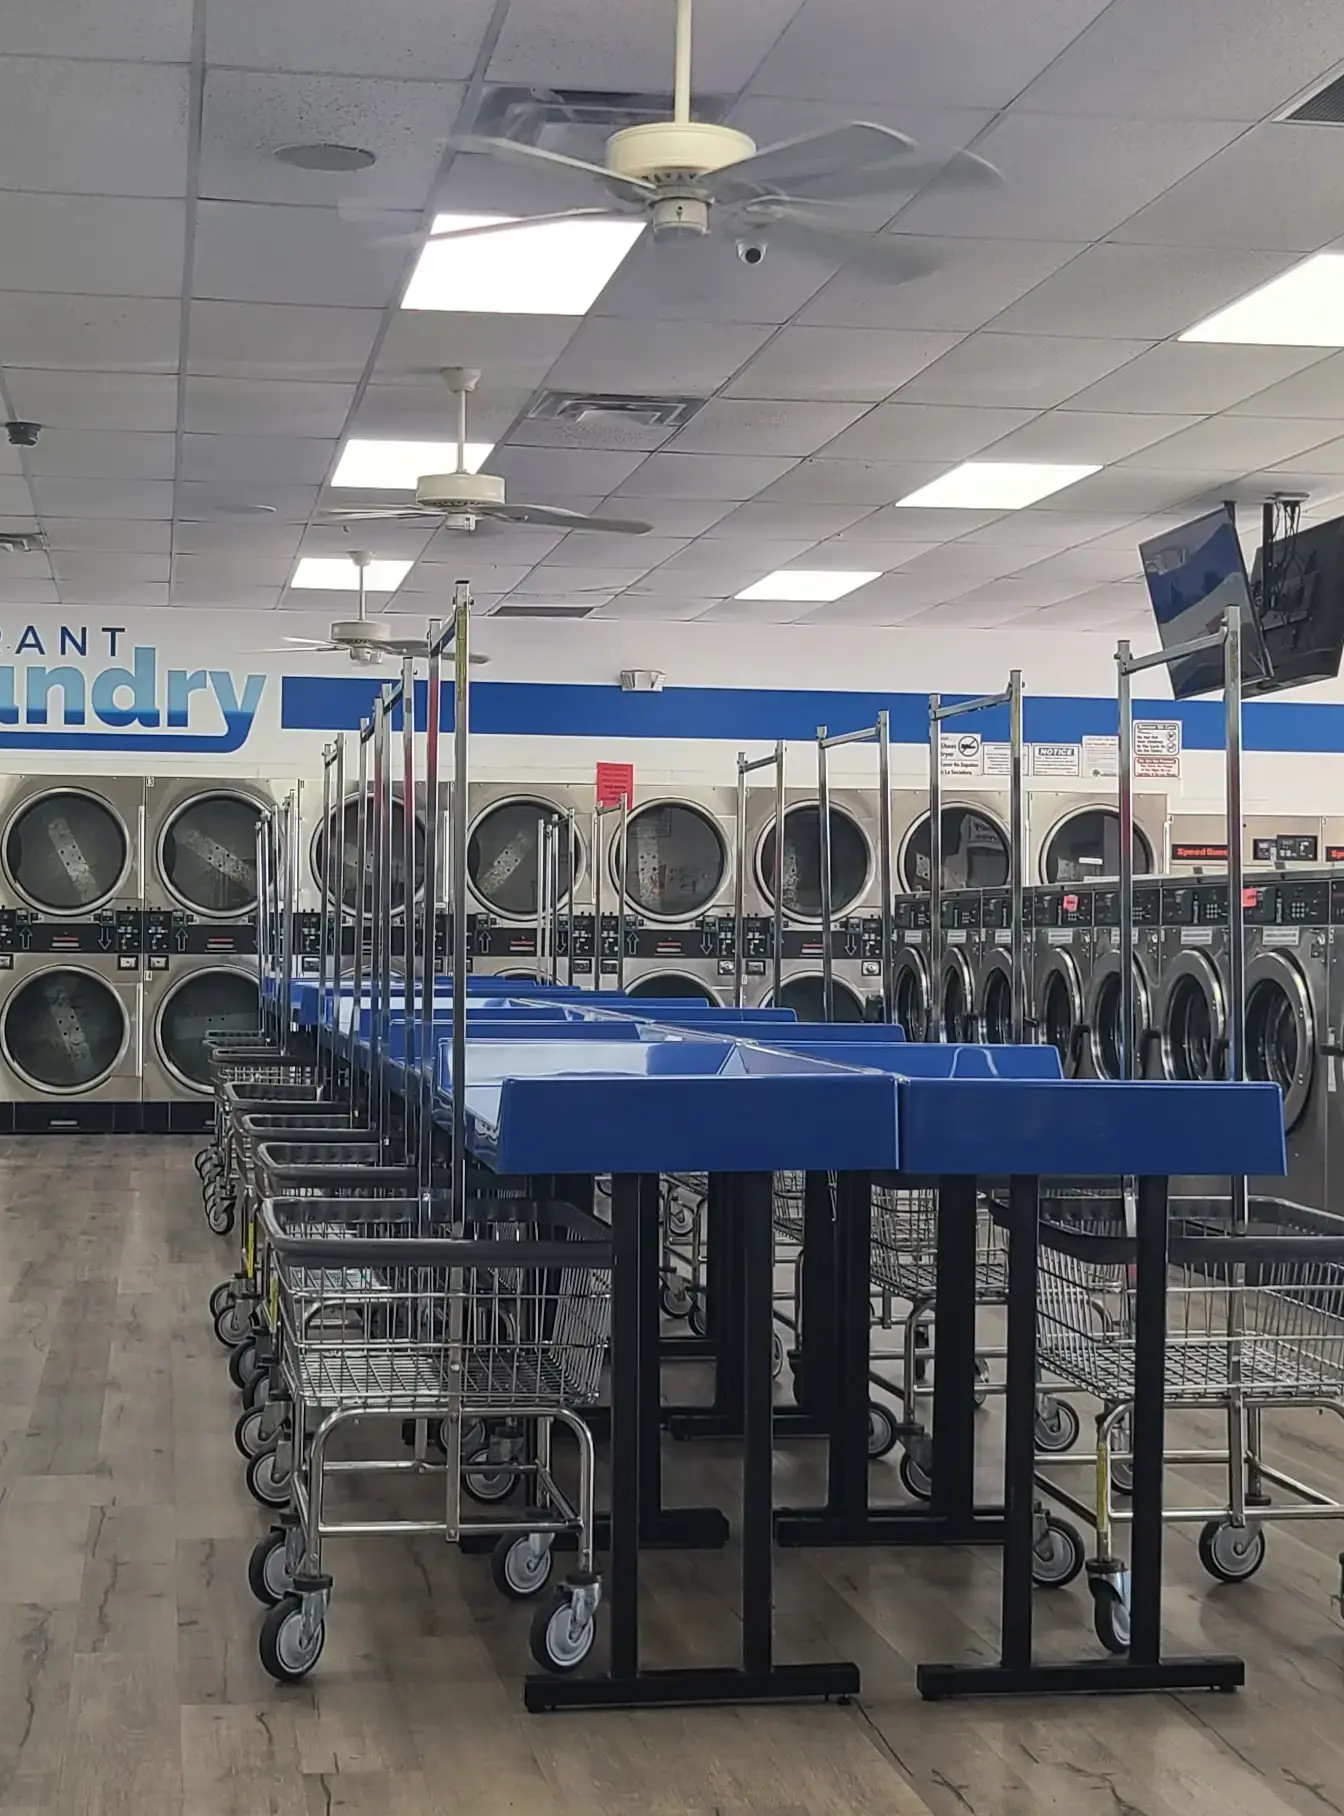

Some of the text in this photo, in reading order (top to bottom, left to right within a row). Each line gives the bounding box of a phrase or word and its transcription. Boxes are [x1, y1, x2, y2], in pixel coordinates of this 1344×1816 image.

[1039, 748, 1073, 756] NOTICE
[1177, 848, 1228, 857] Speed Quee
